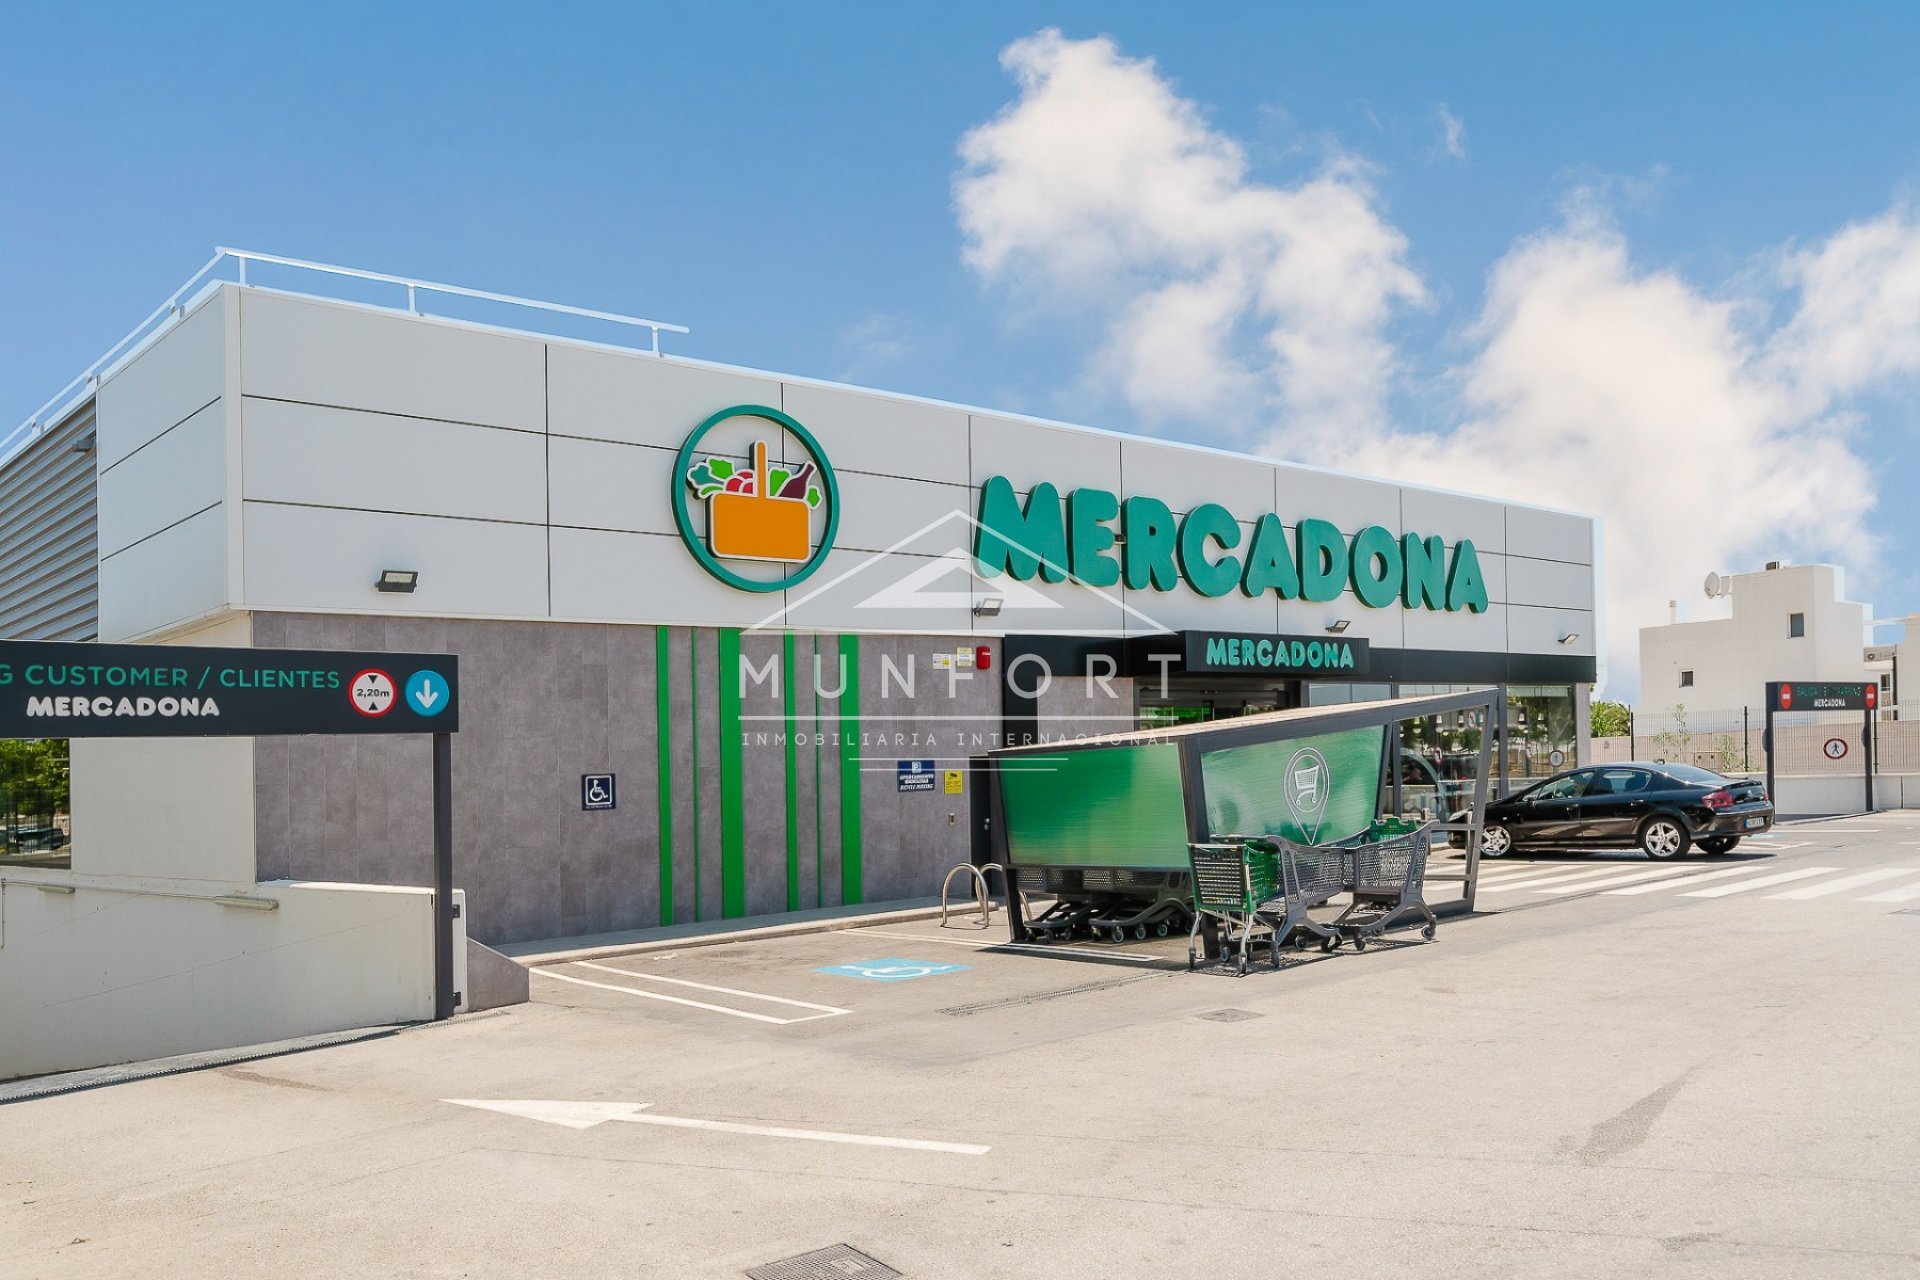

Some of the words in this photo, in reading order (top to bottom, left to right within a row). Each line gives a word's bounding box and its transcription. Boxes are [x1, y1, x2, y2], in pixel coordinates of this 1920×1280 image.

[973, 475, 1488, 614] MERCADONA
[1206, 637, 1355, 669] MERCADONA
[25, 665, 188, 687] CUSTOMER
[219, 668, 340, 689] CLIENTES
[356, 688, 390, 699] 2,20m
[1813, 698, 1846, 708] MERCADONA
[26, 696, 220, 717] MERCADONA
